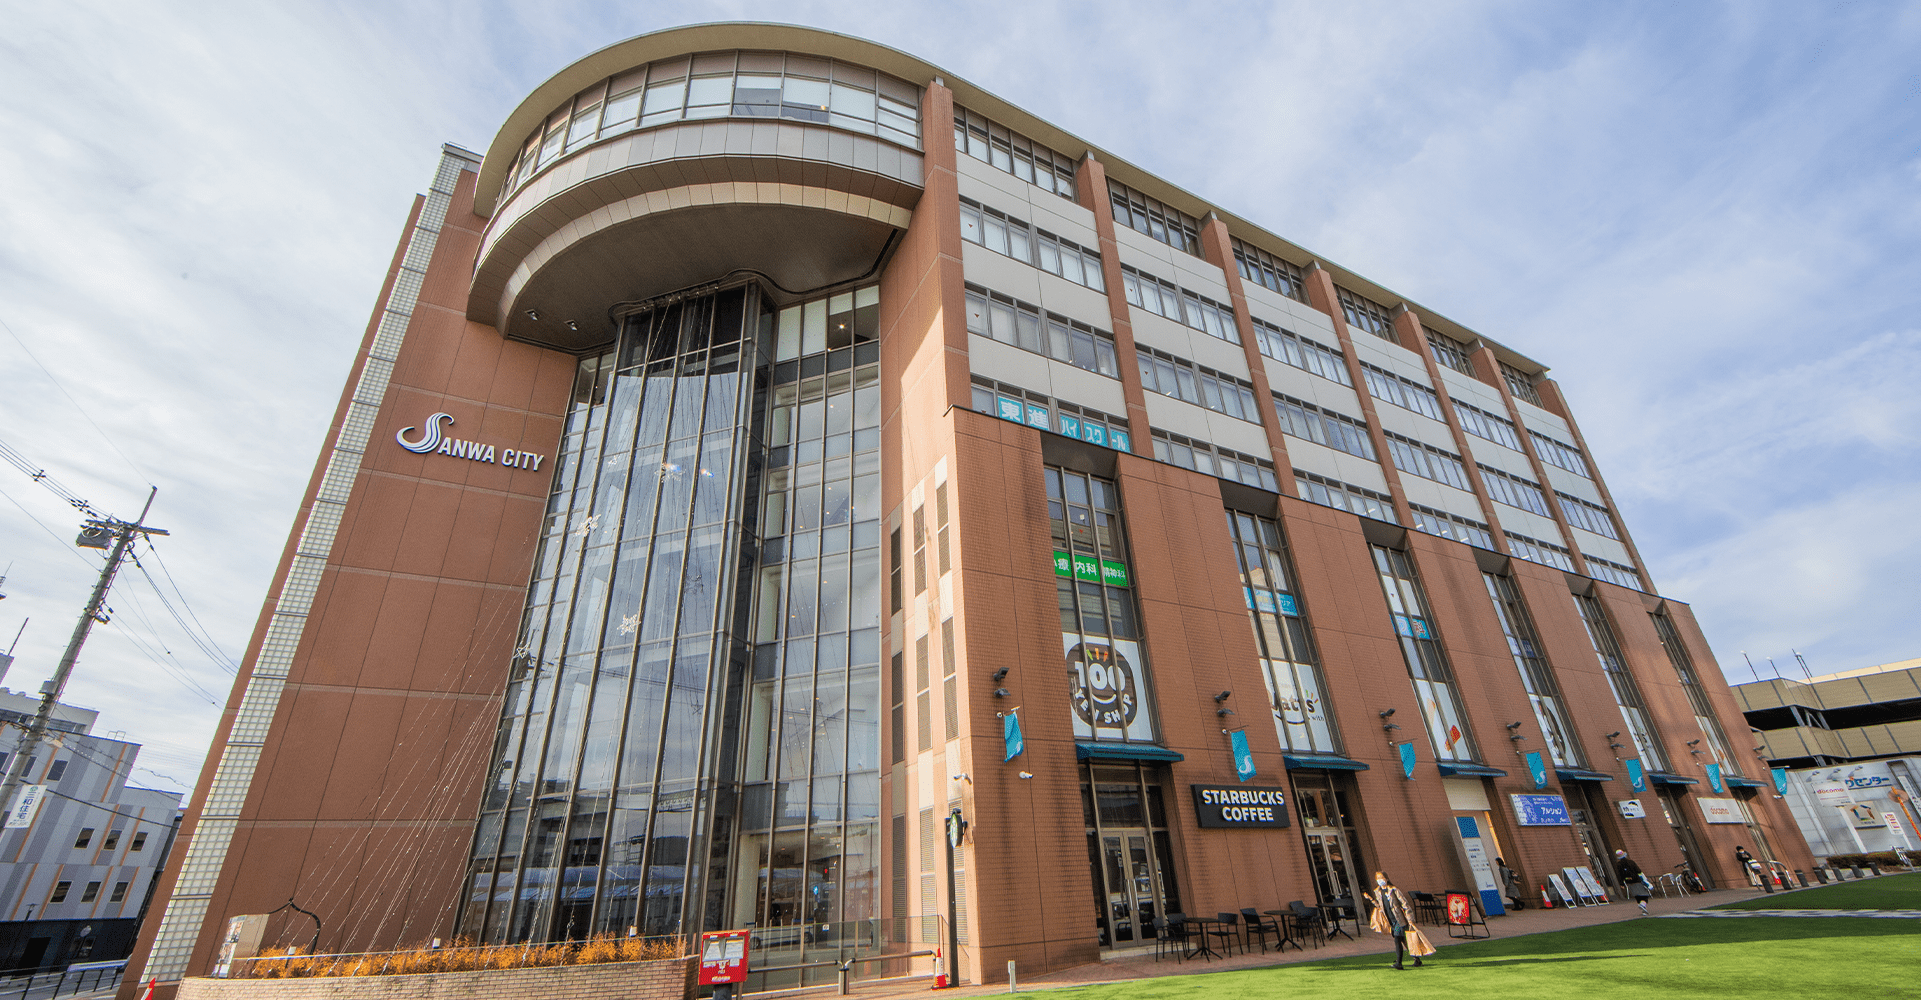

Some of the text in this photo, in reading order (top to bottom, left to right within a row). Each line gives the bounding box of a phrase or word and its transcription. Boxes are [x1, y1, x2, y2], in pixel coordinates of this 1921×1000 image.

[501, 448, 544, 471] CITY
[1075, 661, 1126, 691] 100
[1202, 789, 1285, 806] STARBUCKS
[1222, 806, 1274, 822] COFFEE
